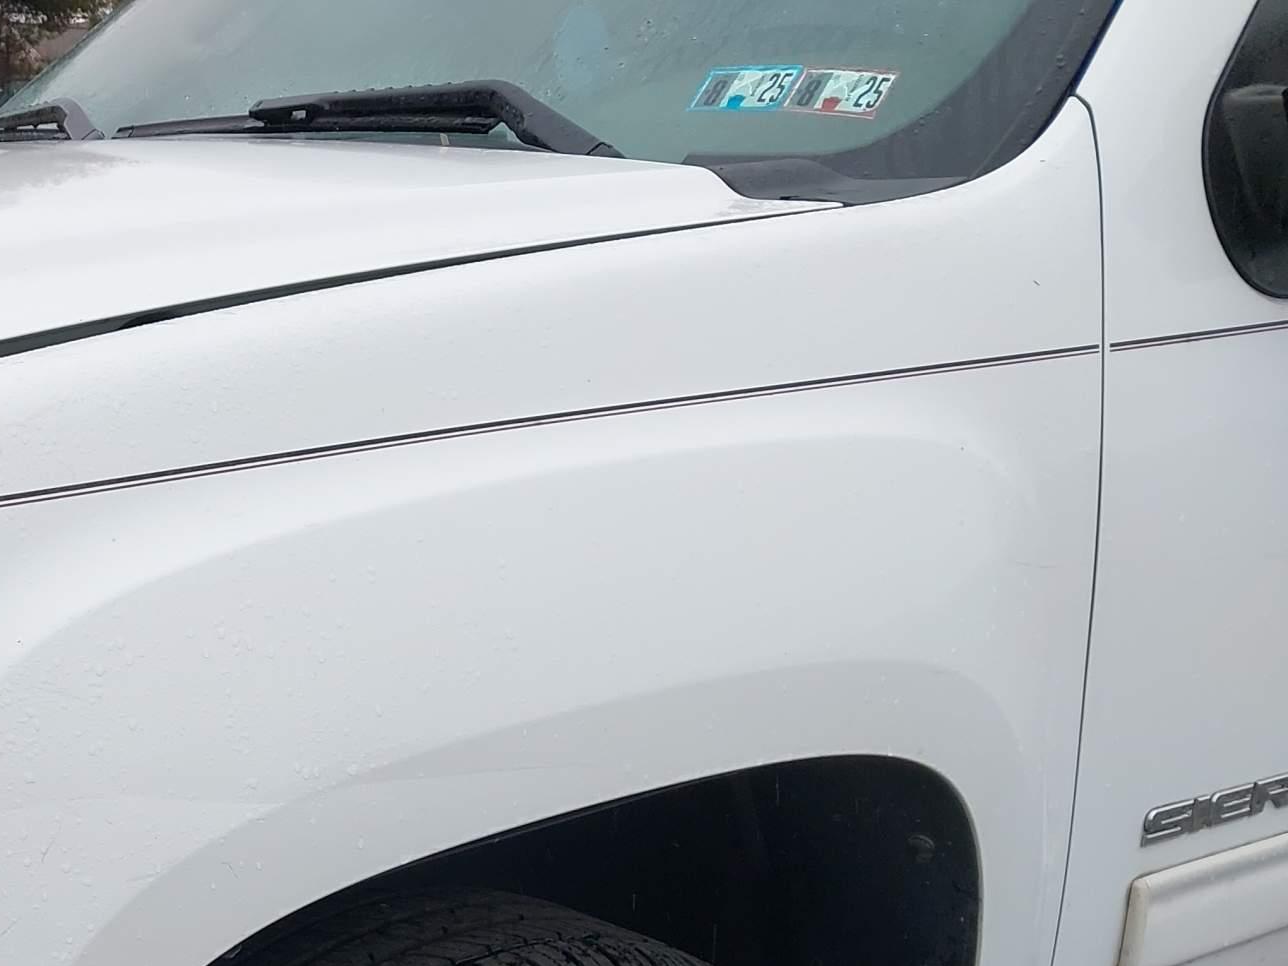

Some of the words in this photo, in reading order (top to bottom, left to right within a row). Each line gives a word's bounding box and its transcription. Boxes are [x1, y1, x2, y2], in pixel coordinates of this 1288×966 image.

[704, 79, 728, 106] 8
[757, 72, 794, 103] 25
[797, 79, 821, 106] 8
[853, 76, 891, 109] 25
